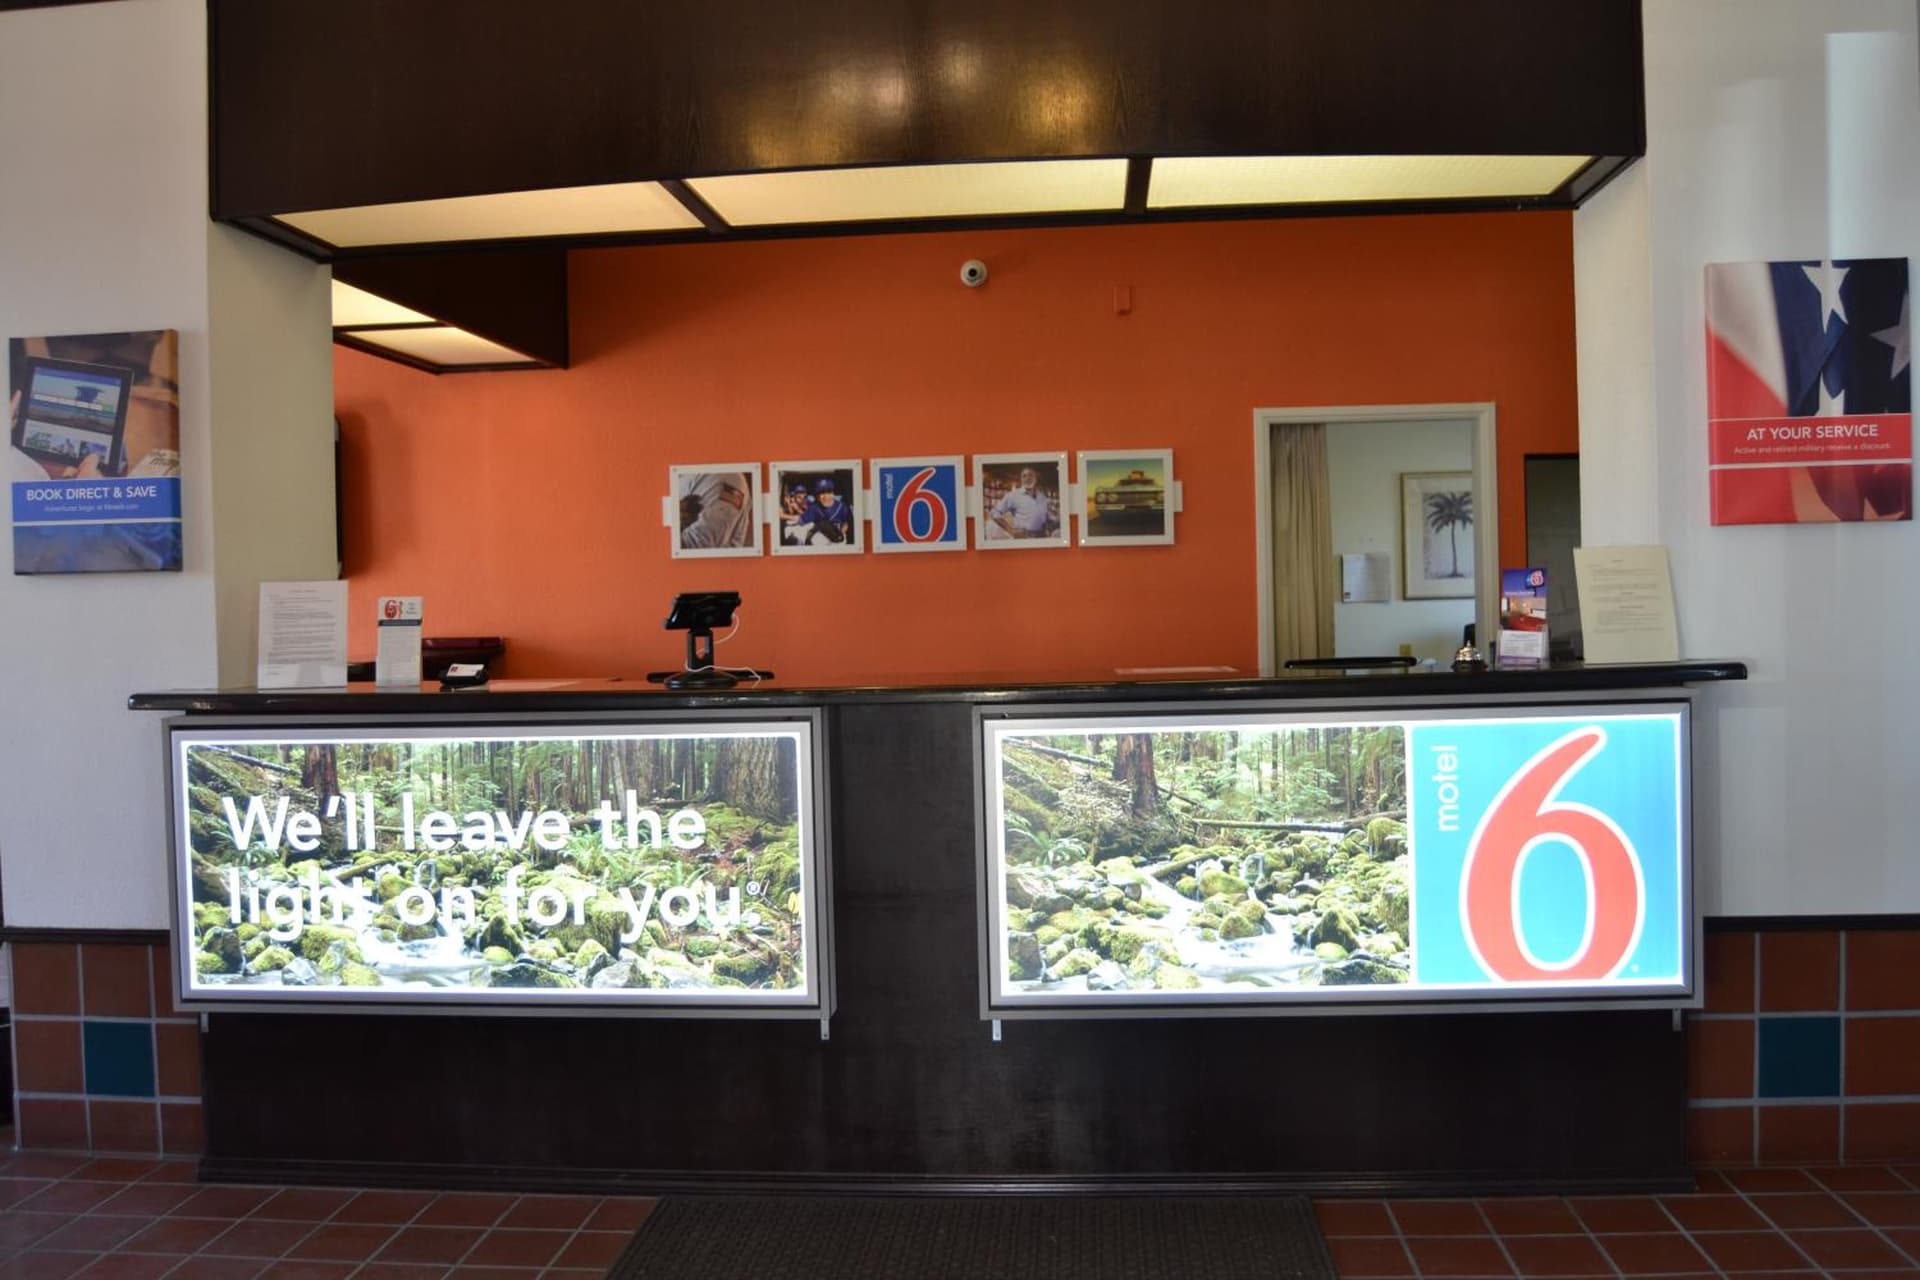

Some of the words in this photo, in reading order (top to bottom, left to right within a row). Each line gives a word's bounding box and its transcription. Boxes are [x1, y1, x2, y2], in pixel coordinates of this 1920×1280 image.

[1747, 428, 1766, 440] AT
[1770, 426, 1812, 439] YOUR
[1815, 424, 1879, 438] SERVICE
[26, 489, 63, 501] BOOK
[66, 487, 110, 500] DIRECT
[113, 487, 122, 499] &
[126, 486, 157, 498] SAVE
[893, 467, 948, 544] 6
[222, 792, 376, 850] We'll
[402, 791, 570, 850] leave
[595, 789, 706, 850] the
[1431, 745, 1460, 832] motel
[1458, 725, 1646, 982] 6
[229, 866, 373, 942] light
[400, 886, 476, 926] on
[501, 865, 597, 926] for
